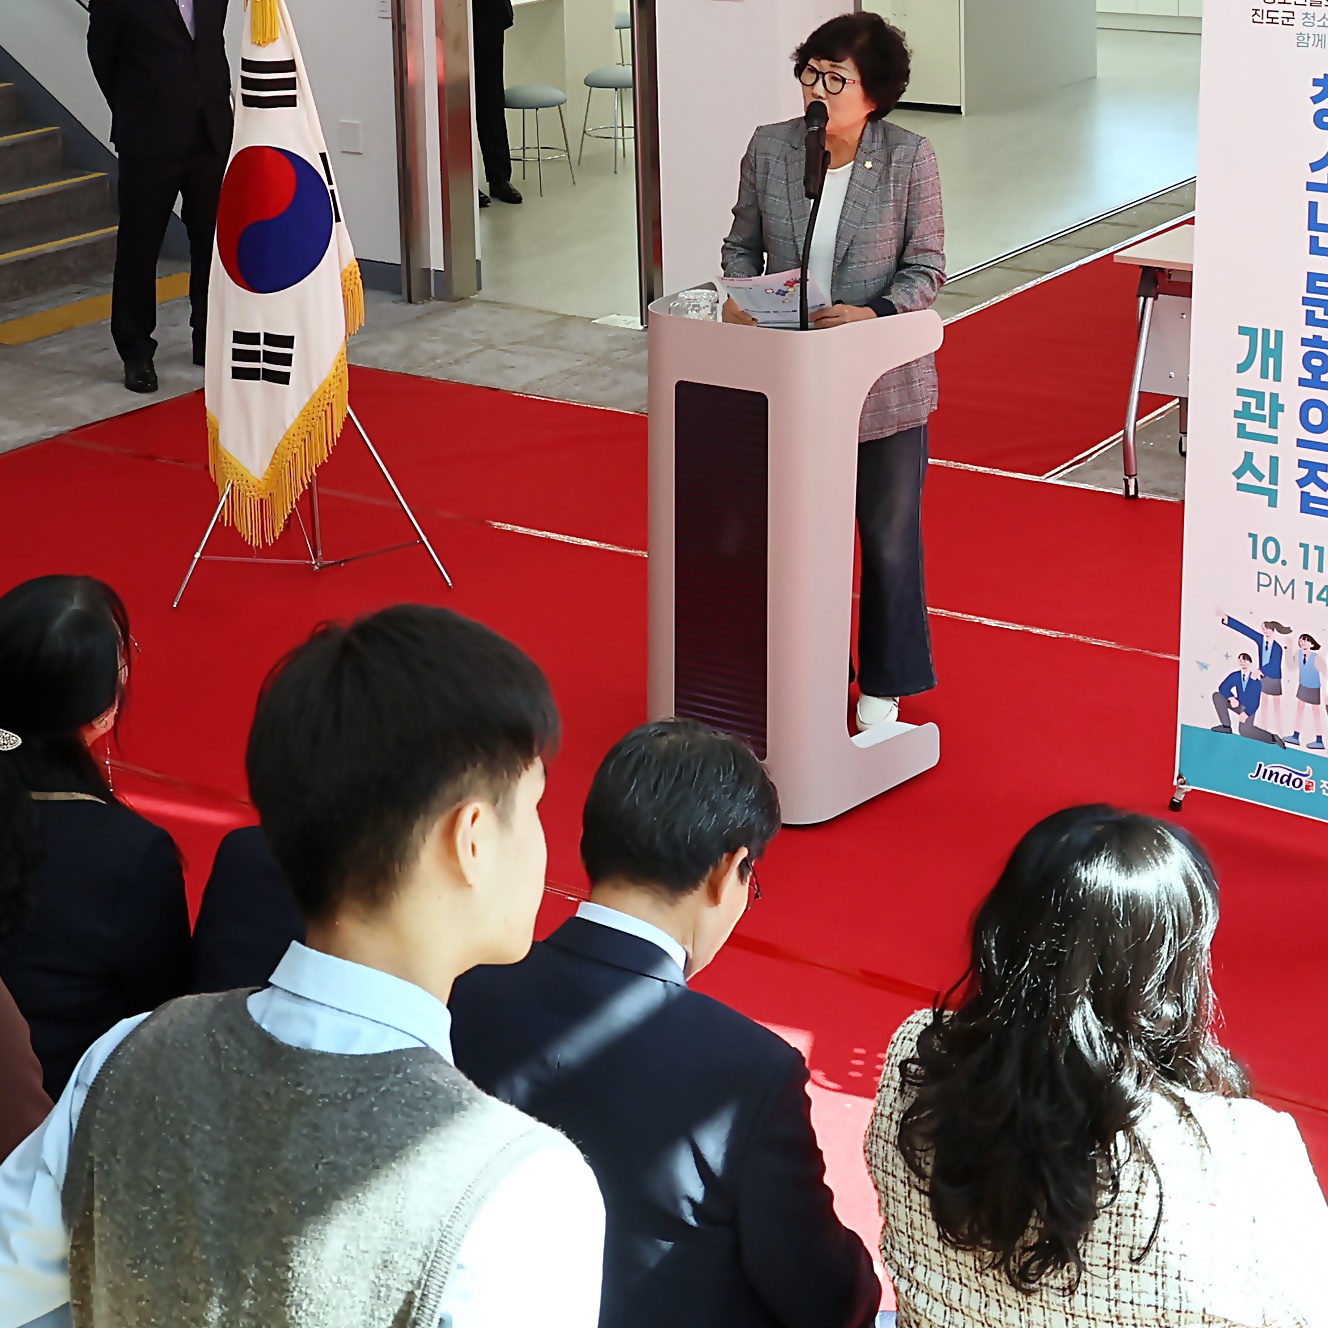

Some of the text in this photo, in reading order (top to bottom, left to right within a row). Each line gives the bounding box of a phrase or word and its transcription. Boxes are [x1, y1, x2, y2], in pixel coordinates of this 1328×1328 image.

[1250, 8, 1296, 27] 진도군
[1295, 32, 1327, 50] 함께
[1232, 325, 1285, 508] 개관식
[1247, 532, 1287, 567] 10.
[1256, 571, 1295, 601] PM
[1249, 762, 1304, 789] Jindo
